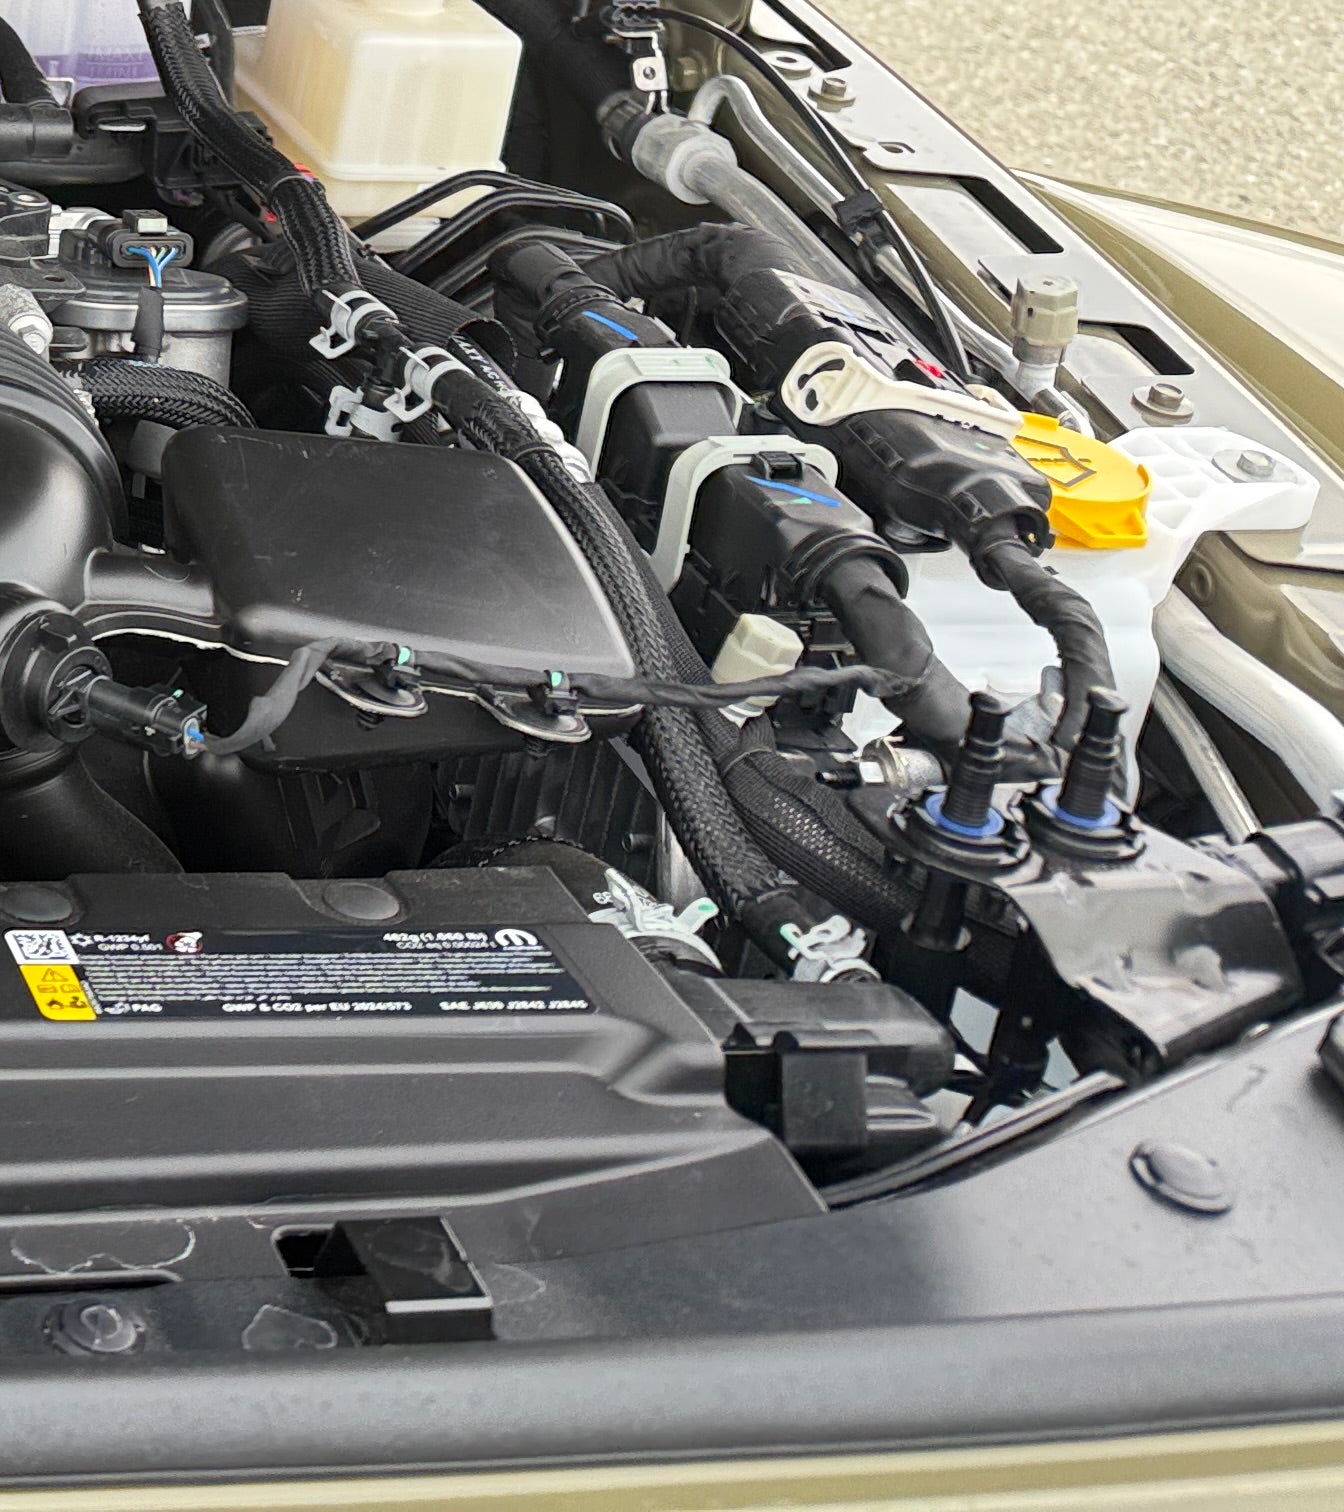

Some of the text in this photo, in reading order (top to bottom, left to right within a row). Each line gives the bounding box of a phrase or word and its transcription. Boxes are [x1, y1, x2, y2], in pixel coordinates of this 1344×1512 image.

[132, 1003, 163, 1013] PAG
[222, 1002, 257, 1013] GWP
[439, 1001, 471, 1011] SAE
